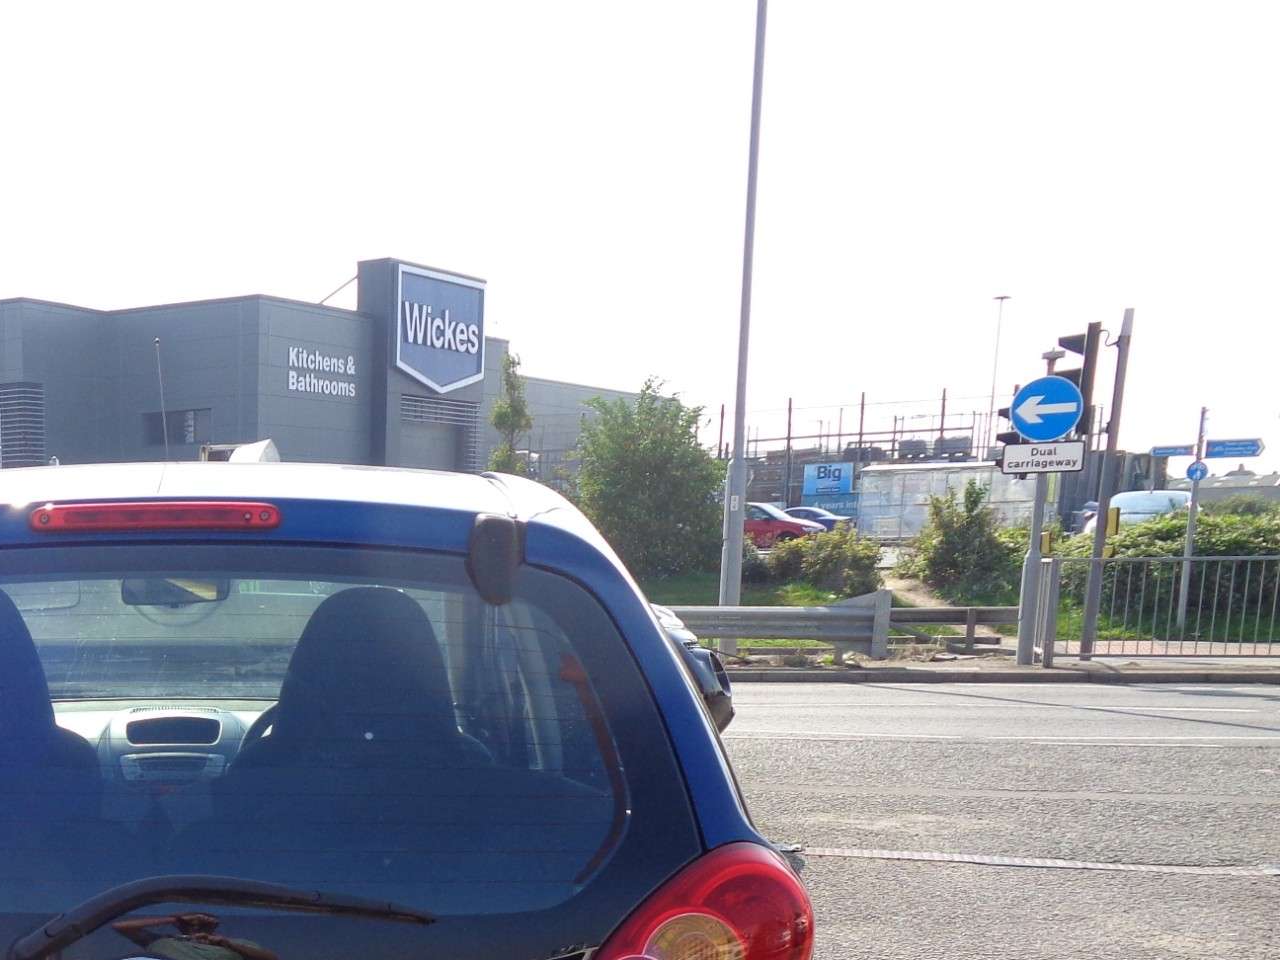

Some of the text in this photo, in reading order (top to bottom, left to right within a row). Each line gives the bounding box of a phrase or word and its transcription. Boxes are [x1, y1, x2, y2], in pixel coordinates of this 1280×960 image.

[405, 301, 479, 354] Wickes
[289, 346, 356, 375] Kitchens &
[288, 370, 356, 397] Bathrooms
[1031, 447, 1057, 457] Dual
[816, 464, 842, 481] Big
[1007, 459, 1078, 469] carriageway
